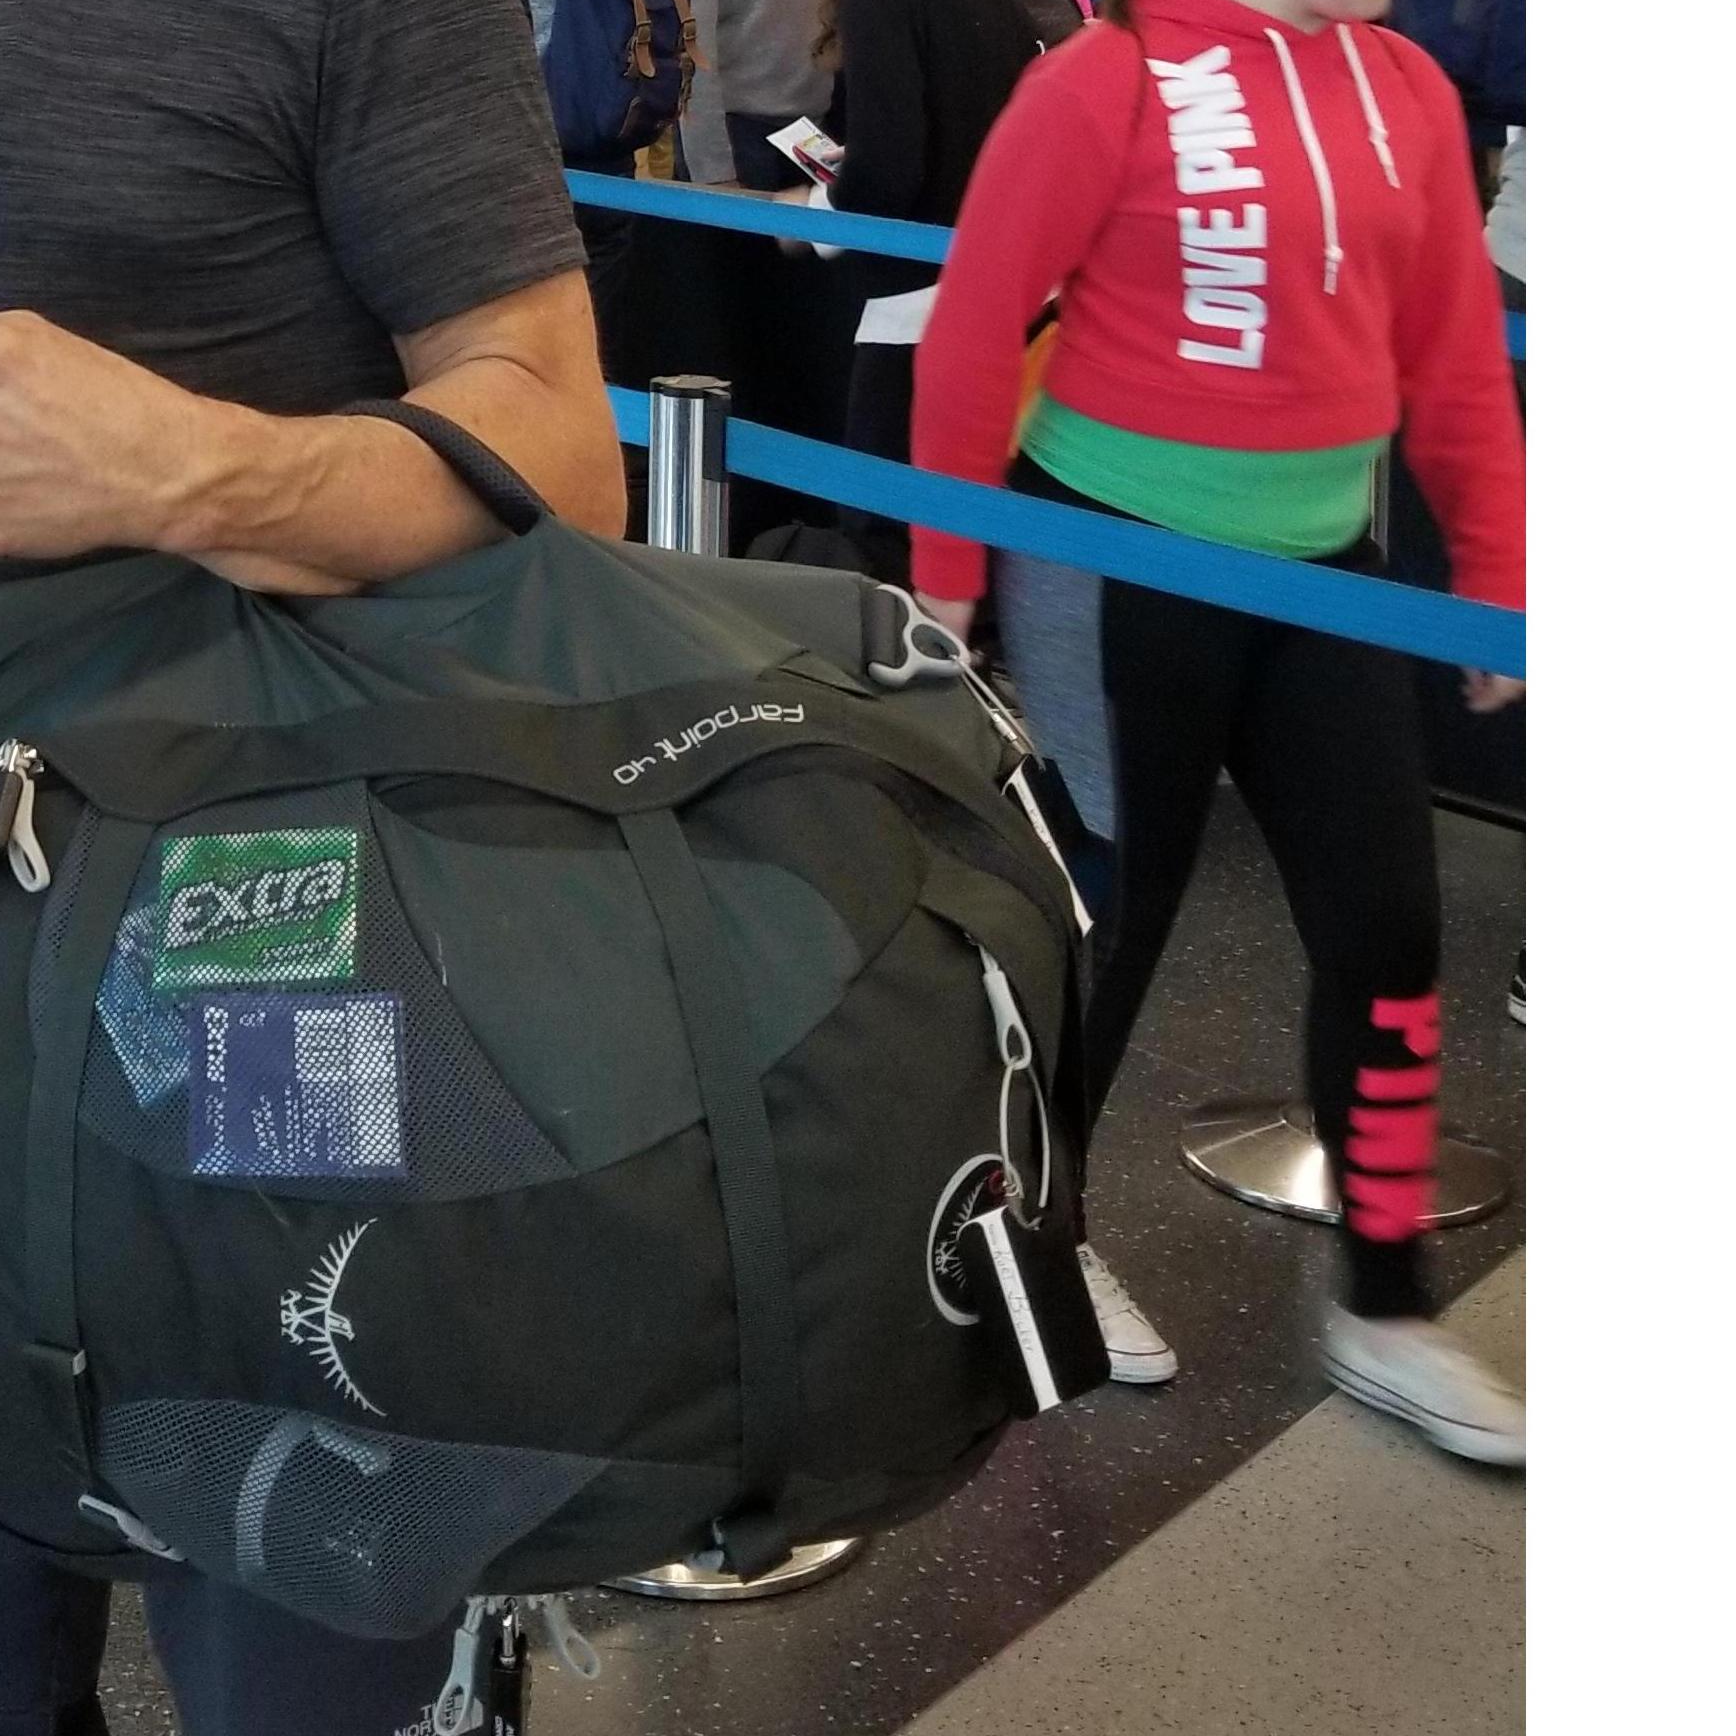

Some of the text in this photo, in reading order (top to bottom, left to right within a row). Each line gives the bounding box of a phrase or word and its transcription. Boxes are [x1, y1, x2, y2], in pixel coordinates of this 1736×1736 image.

[1146, 45, 1268, 369] LOVE PINK
[612, 754, 658, 785] 40
